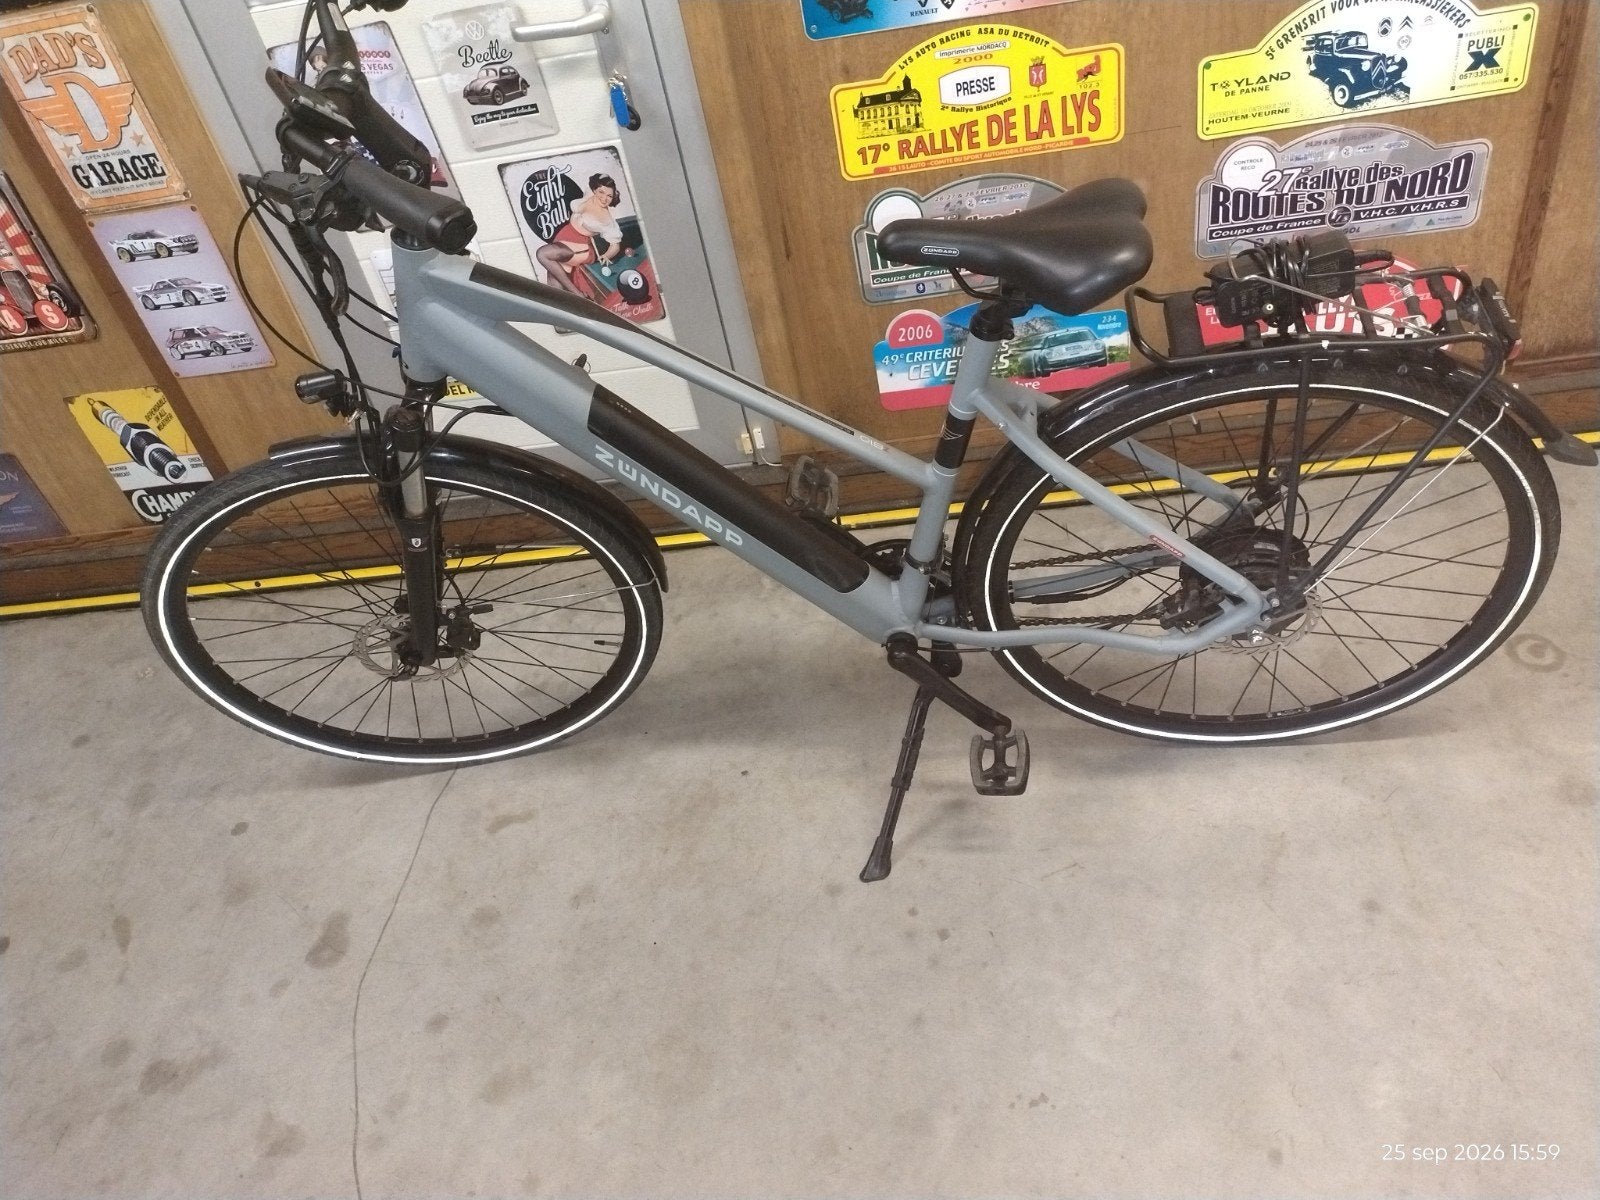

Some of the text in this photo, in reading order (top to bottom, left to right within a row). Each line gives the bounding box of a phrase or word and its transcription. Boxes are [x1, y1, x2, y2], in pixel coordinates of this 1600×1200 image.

[910, 8, 938, 17] RENAULT
[1276, 6, 1326, 49] GRENSRIT
[898, 27, 1050, 71] LYS AUTO RACING ASA DU DETROIT
[1467, 35, 1505, 51] PUBLI
[7, 31, 106, 84] DAD'S
[458, 39, 513, 70] Beetle
[953, 53, 994, 65] 2000
[955, 76, 996, 97] PRESSE
[1240, 84, 1270, 95] PANNE
[950, 105, 974, 114] Rallye
[975, 96, 1012, 112] Historique
[897, 119, 980, 160] RALLYE
[986, 108, 1018, 147] DE
[1024, 100, 1055, 141] LA
[1060, 89, 1101, 136] LYS
[1208, 108, 1290, 125] HOUTEM-VEURNE
[1294, 166, 1361, 191] Rallye
[1365, 161, 1404, 184] des
[523, 164, 572, 212] Eight
[1208, 151, 1475, 227] ROUTES DU NORD
[536, 198, 570, 239] Ball
[1212, 227, 1254, 239] Coupe
[1256, 222, 1274, 232] de
[1276, 217, 1322, 230] France
[631, 277, 640, 286] 8
[873, 275, 906, 285] Coupe
[898, 324, 933, 342] 2006
[905, 345, 966, 363] CRITERIU
